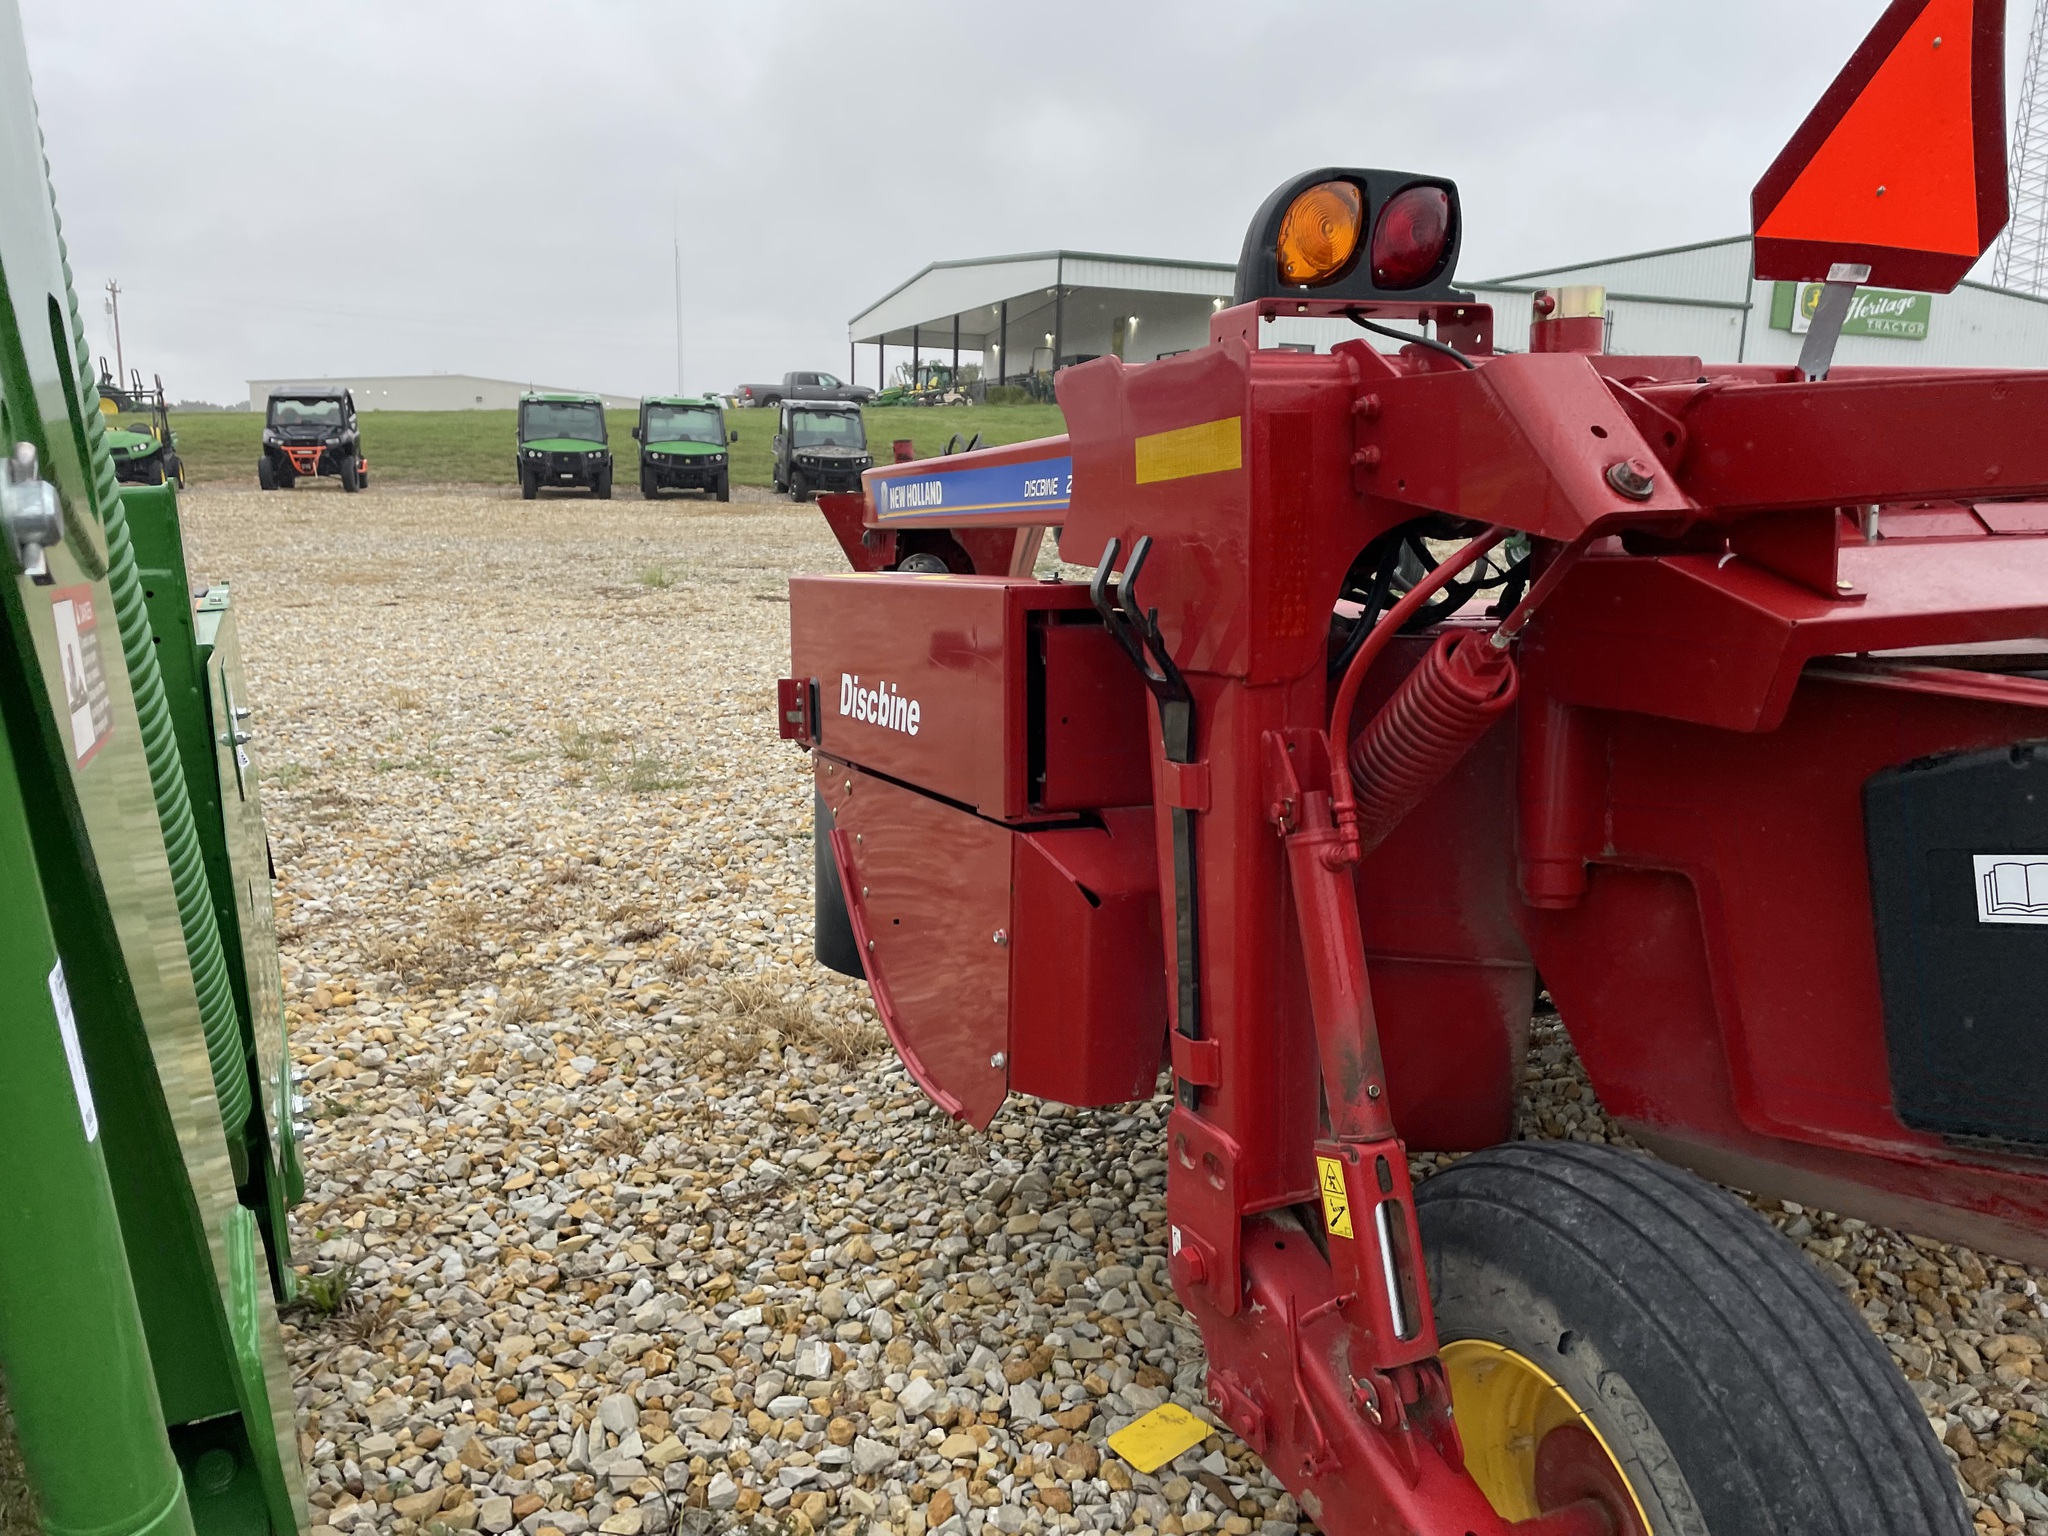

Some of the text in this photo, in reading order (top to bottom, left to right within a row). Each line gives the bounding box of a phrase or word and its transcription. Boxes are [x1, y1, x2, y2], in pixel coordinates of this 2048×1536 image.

[1843, 294, 1916, 324] Heritage
[1866, 318, 1925, 335] TRACTOR
[889, 480, 943, 510] NEW HOLLAND
[1024, 477, 1059, 498] DISCBINE
[839, 672, 921, 736] Discbine
